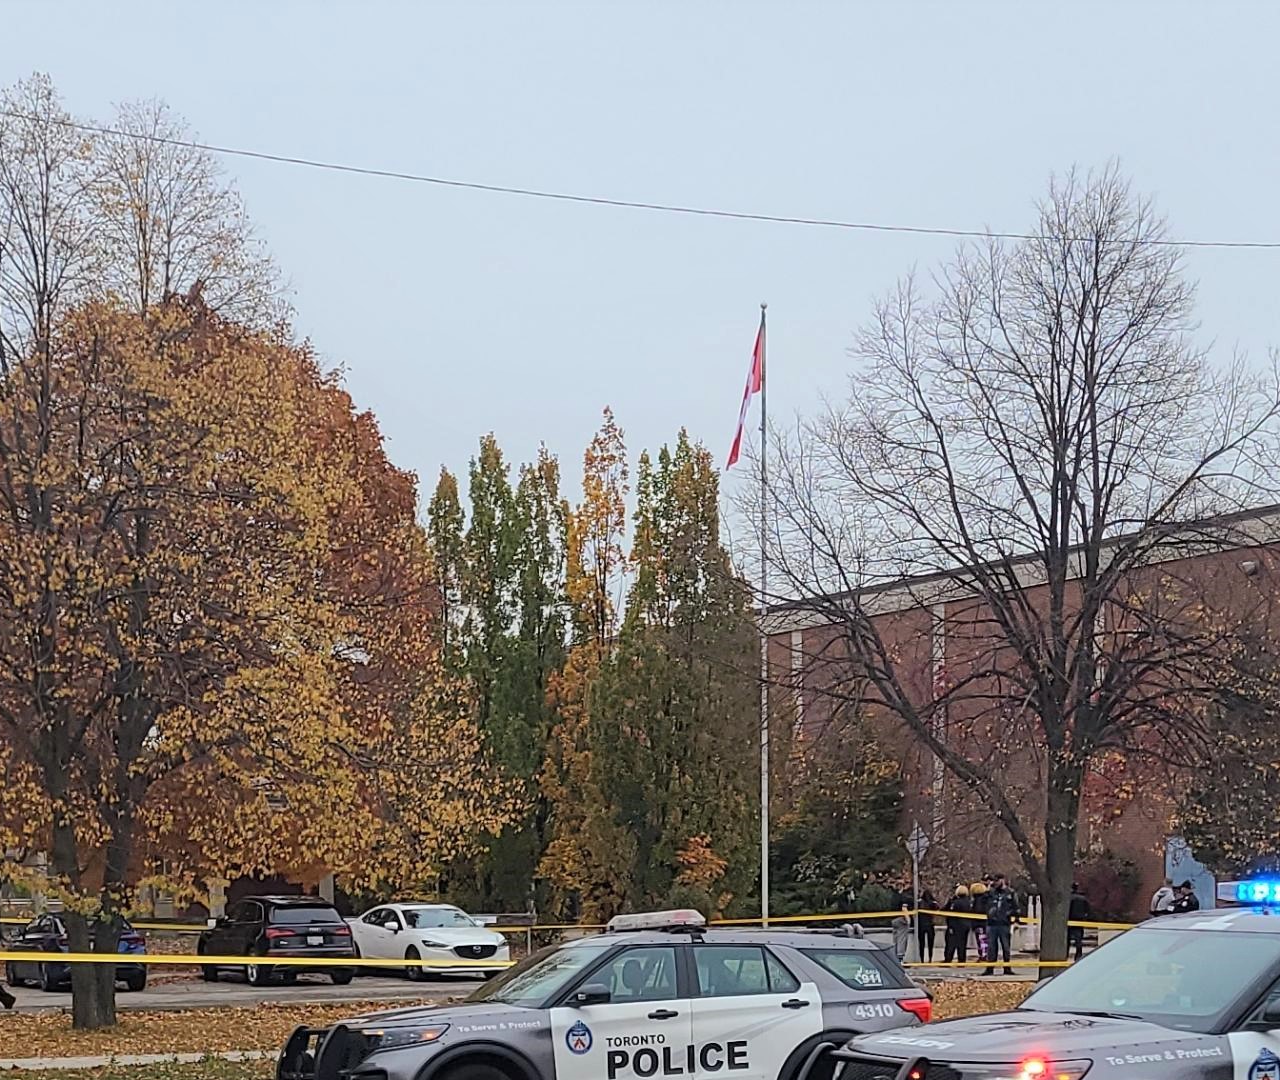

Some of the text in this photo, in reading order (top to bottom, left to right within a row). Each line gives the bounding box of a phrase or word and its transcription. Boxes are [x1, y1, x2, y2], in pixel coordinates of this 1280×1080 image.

[861, 973, 882, 984] 911
[855, 1003, 894, 1018] 4310
[508, 1020, 541, 1030] Protect
[605, 1033, 666, 1048] TORONTO
[607, 1040, 750, 1080] POLICE
[1105, 1046, 1223, 1066] To Serve & Protect
